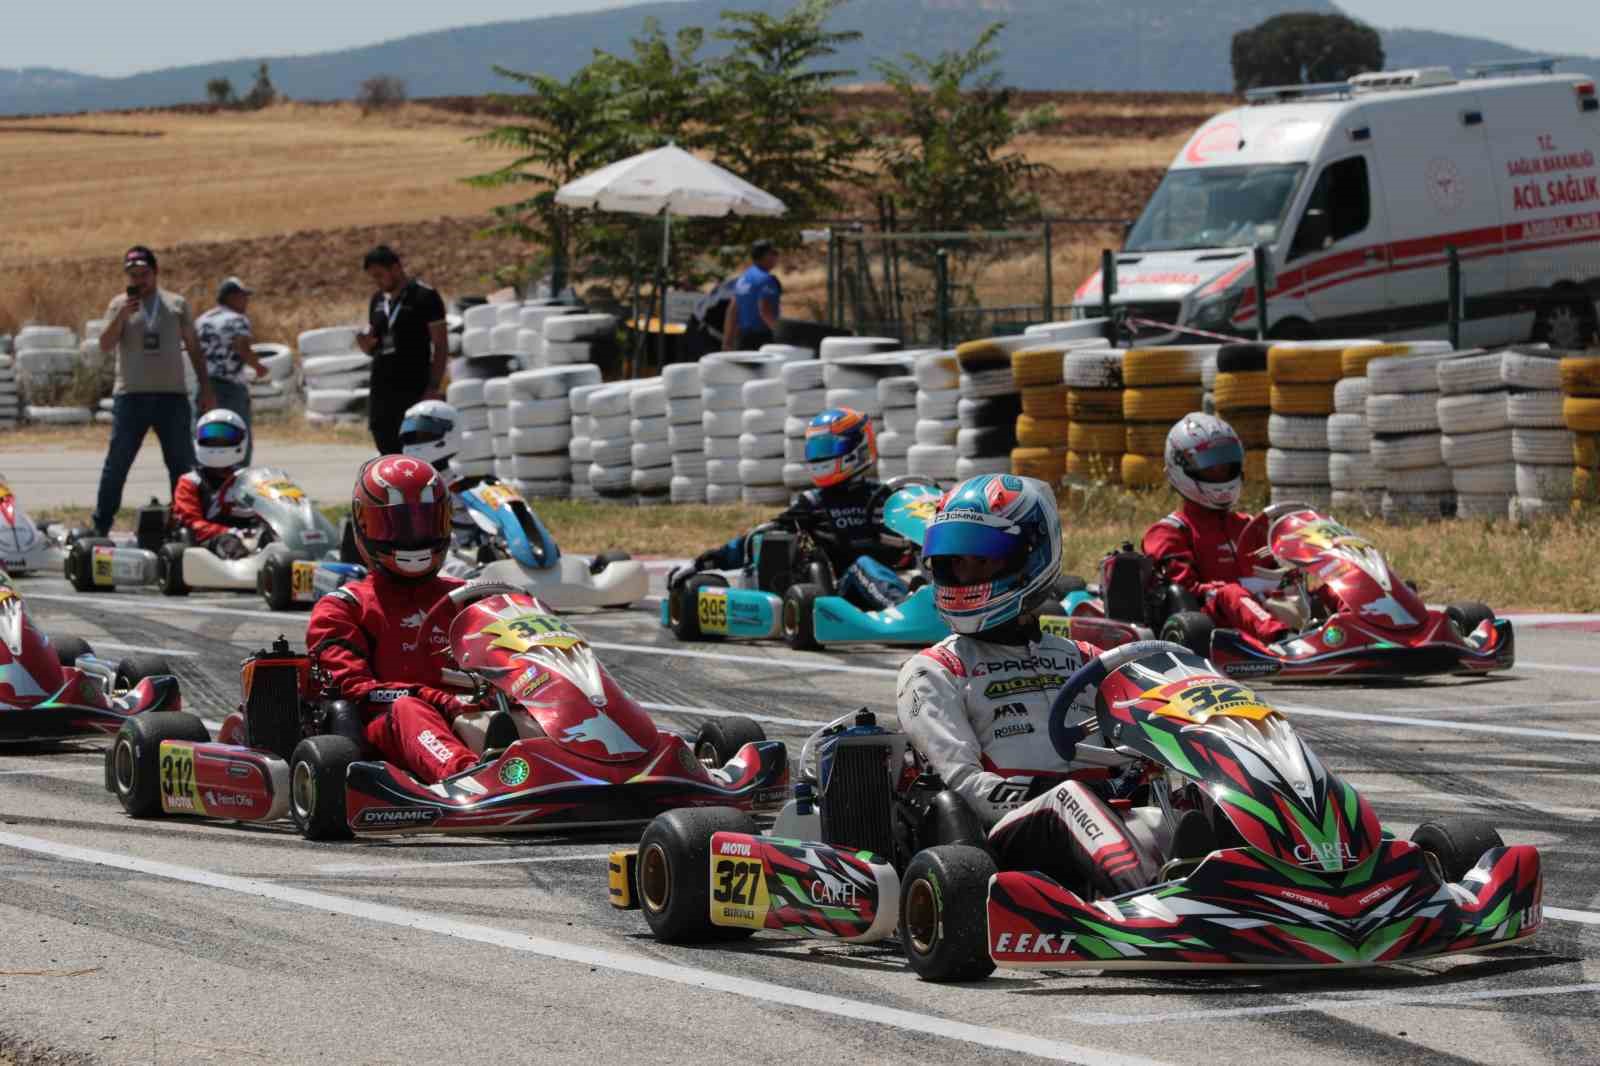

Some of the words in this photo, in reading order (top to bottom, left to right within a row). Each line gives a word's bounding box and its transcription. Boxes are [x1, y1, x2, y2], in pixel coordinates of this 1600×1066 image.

[1547, 173, 1600, 206] SAĞLIK
[700, 597, 727, 627] 395
[1180, 684, 1250, 716] 32
[418, 730, 454, 762] sparco
[162, 755, 193, 797] 312
[365, 811, 433, 821] DYNAMIC
[1055, 787, 1104, 840] BIRINCI
[720, 842, 752, 857] MOTUL
[1293, 842, 1358, 861] CAREL
[714, 859, 762, 906] 327
[810, 880, 861, 907] CAREL
[995, 932, 1077, 955] E.E.K.T.
